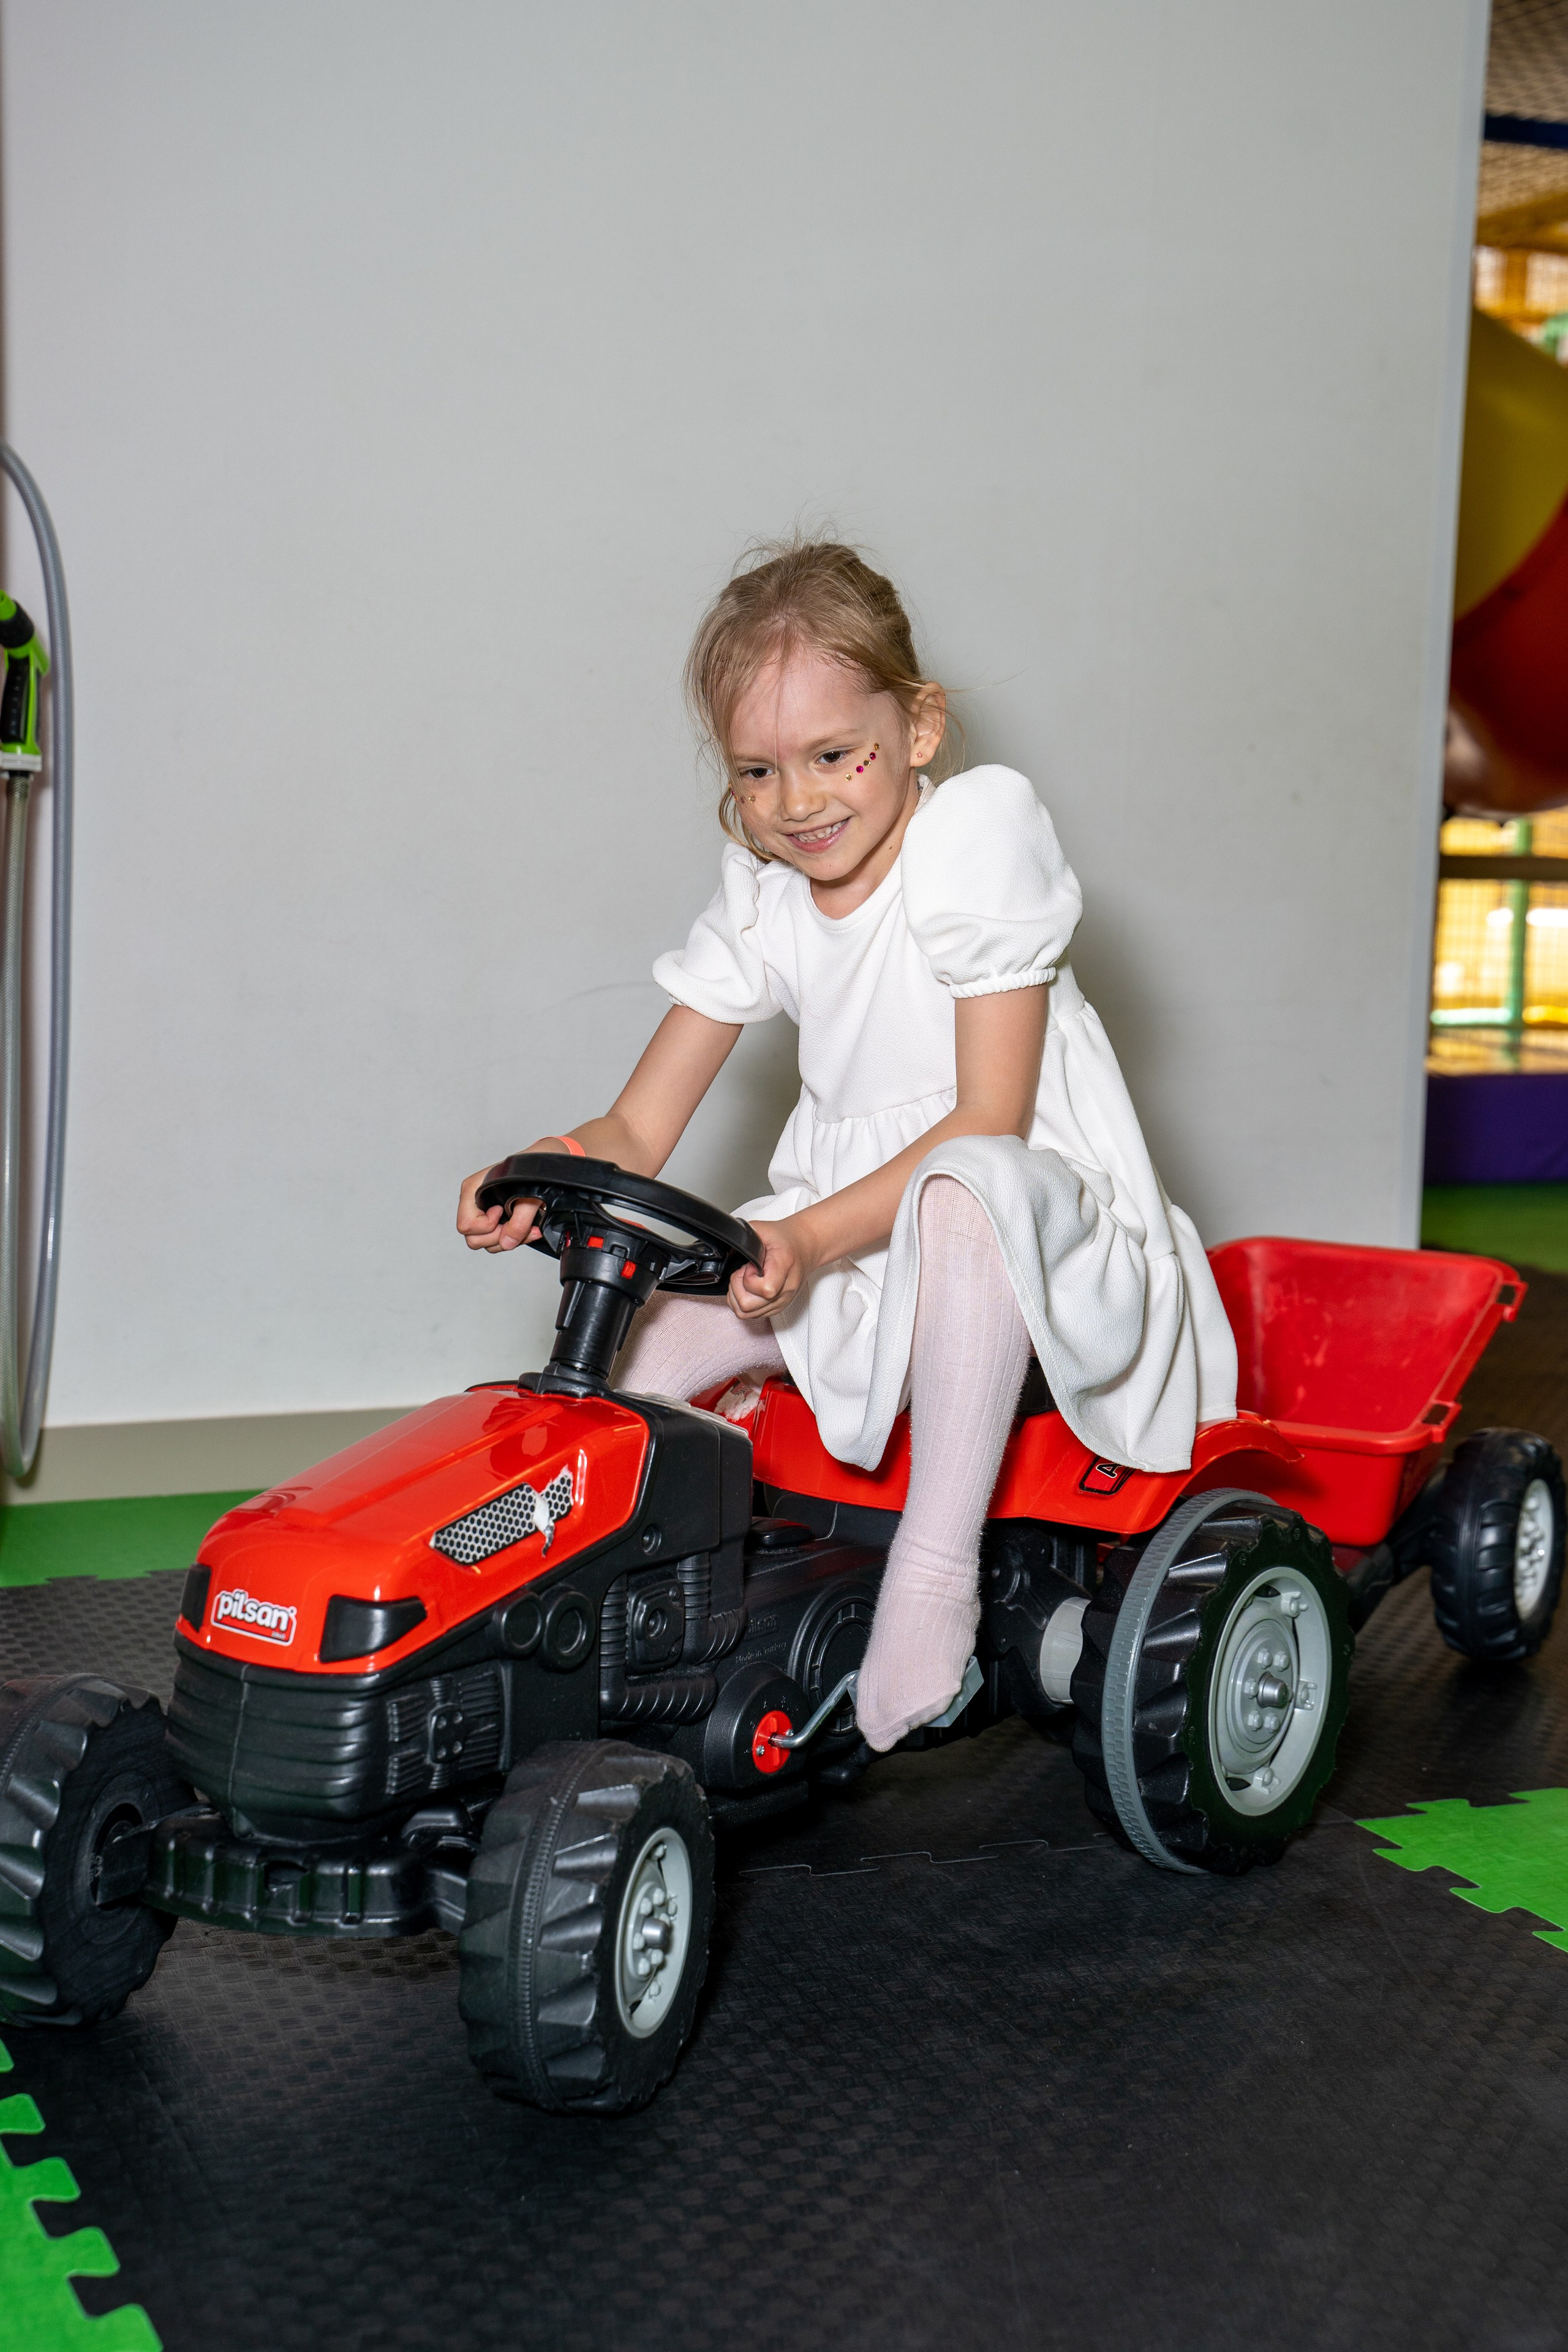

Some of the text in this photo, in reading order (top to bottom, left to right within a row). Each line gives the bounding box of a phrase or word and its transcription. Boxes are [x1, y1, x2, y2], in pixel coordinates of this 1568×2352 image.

[216, 1591, 289, 1632] pilsan
[736, 1651, 754, 1664] Made
[755, 1649, 762, 1658] in
